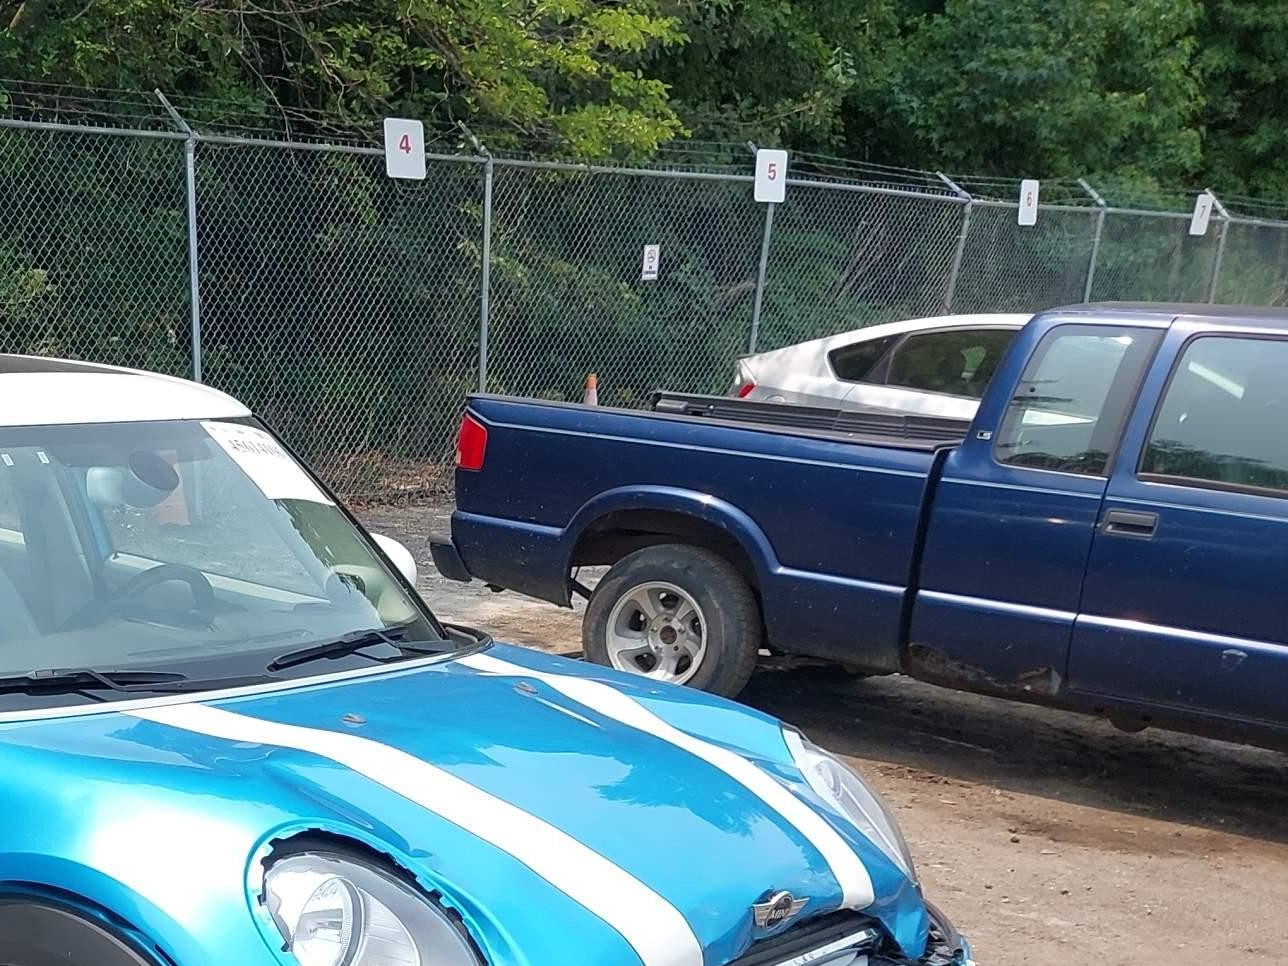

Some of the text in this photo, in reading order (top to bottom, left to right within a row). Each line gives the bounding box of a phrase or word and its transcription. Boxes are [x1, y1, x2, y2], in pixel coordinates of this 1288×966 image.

[399, 134, 412, 154] 4
[768, 163, 777, 180] 5
[1027, 191, 1033, 207] 6
